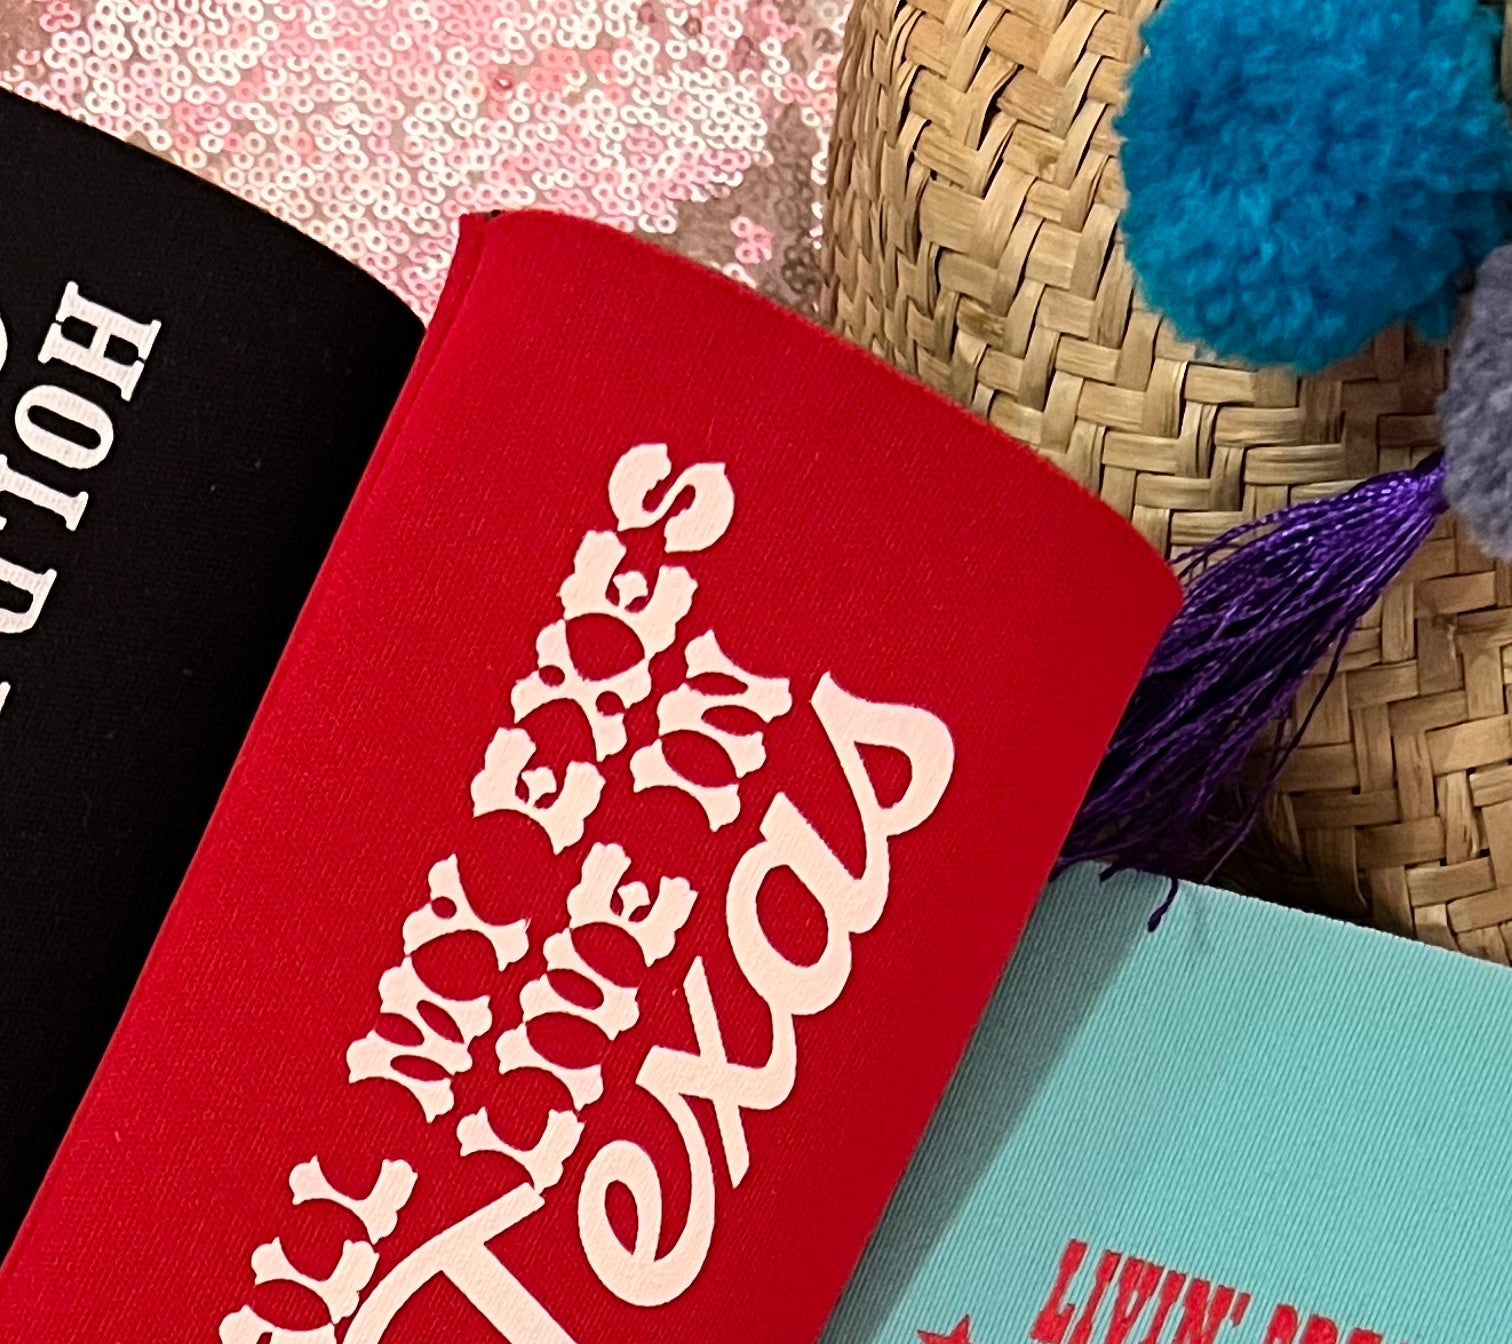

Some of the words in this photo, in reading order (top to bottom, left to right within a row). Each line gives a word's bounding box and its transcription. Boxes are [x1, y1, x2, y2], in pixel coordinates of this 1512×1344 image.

[346, 853, 531, 1123] MY
[470, 443, 735, 855] EXES
[457, 841, 698, 1197] LIVE
[629, 629, 793, 833] IN
